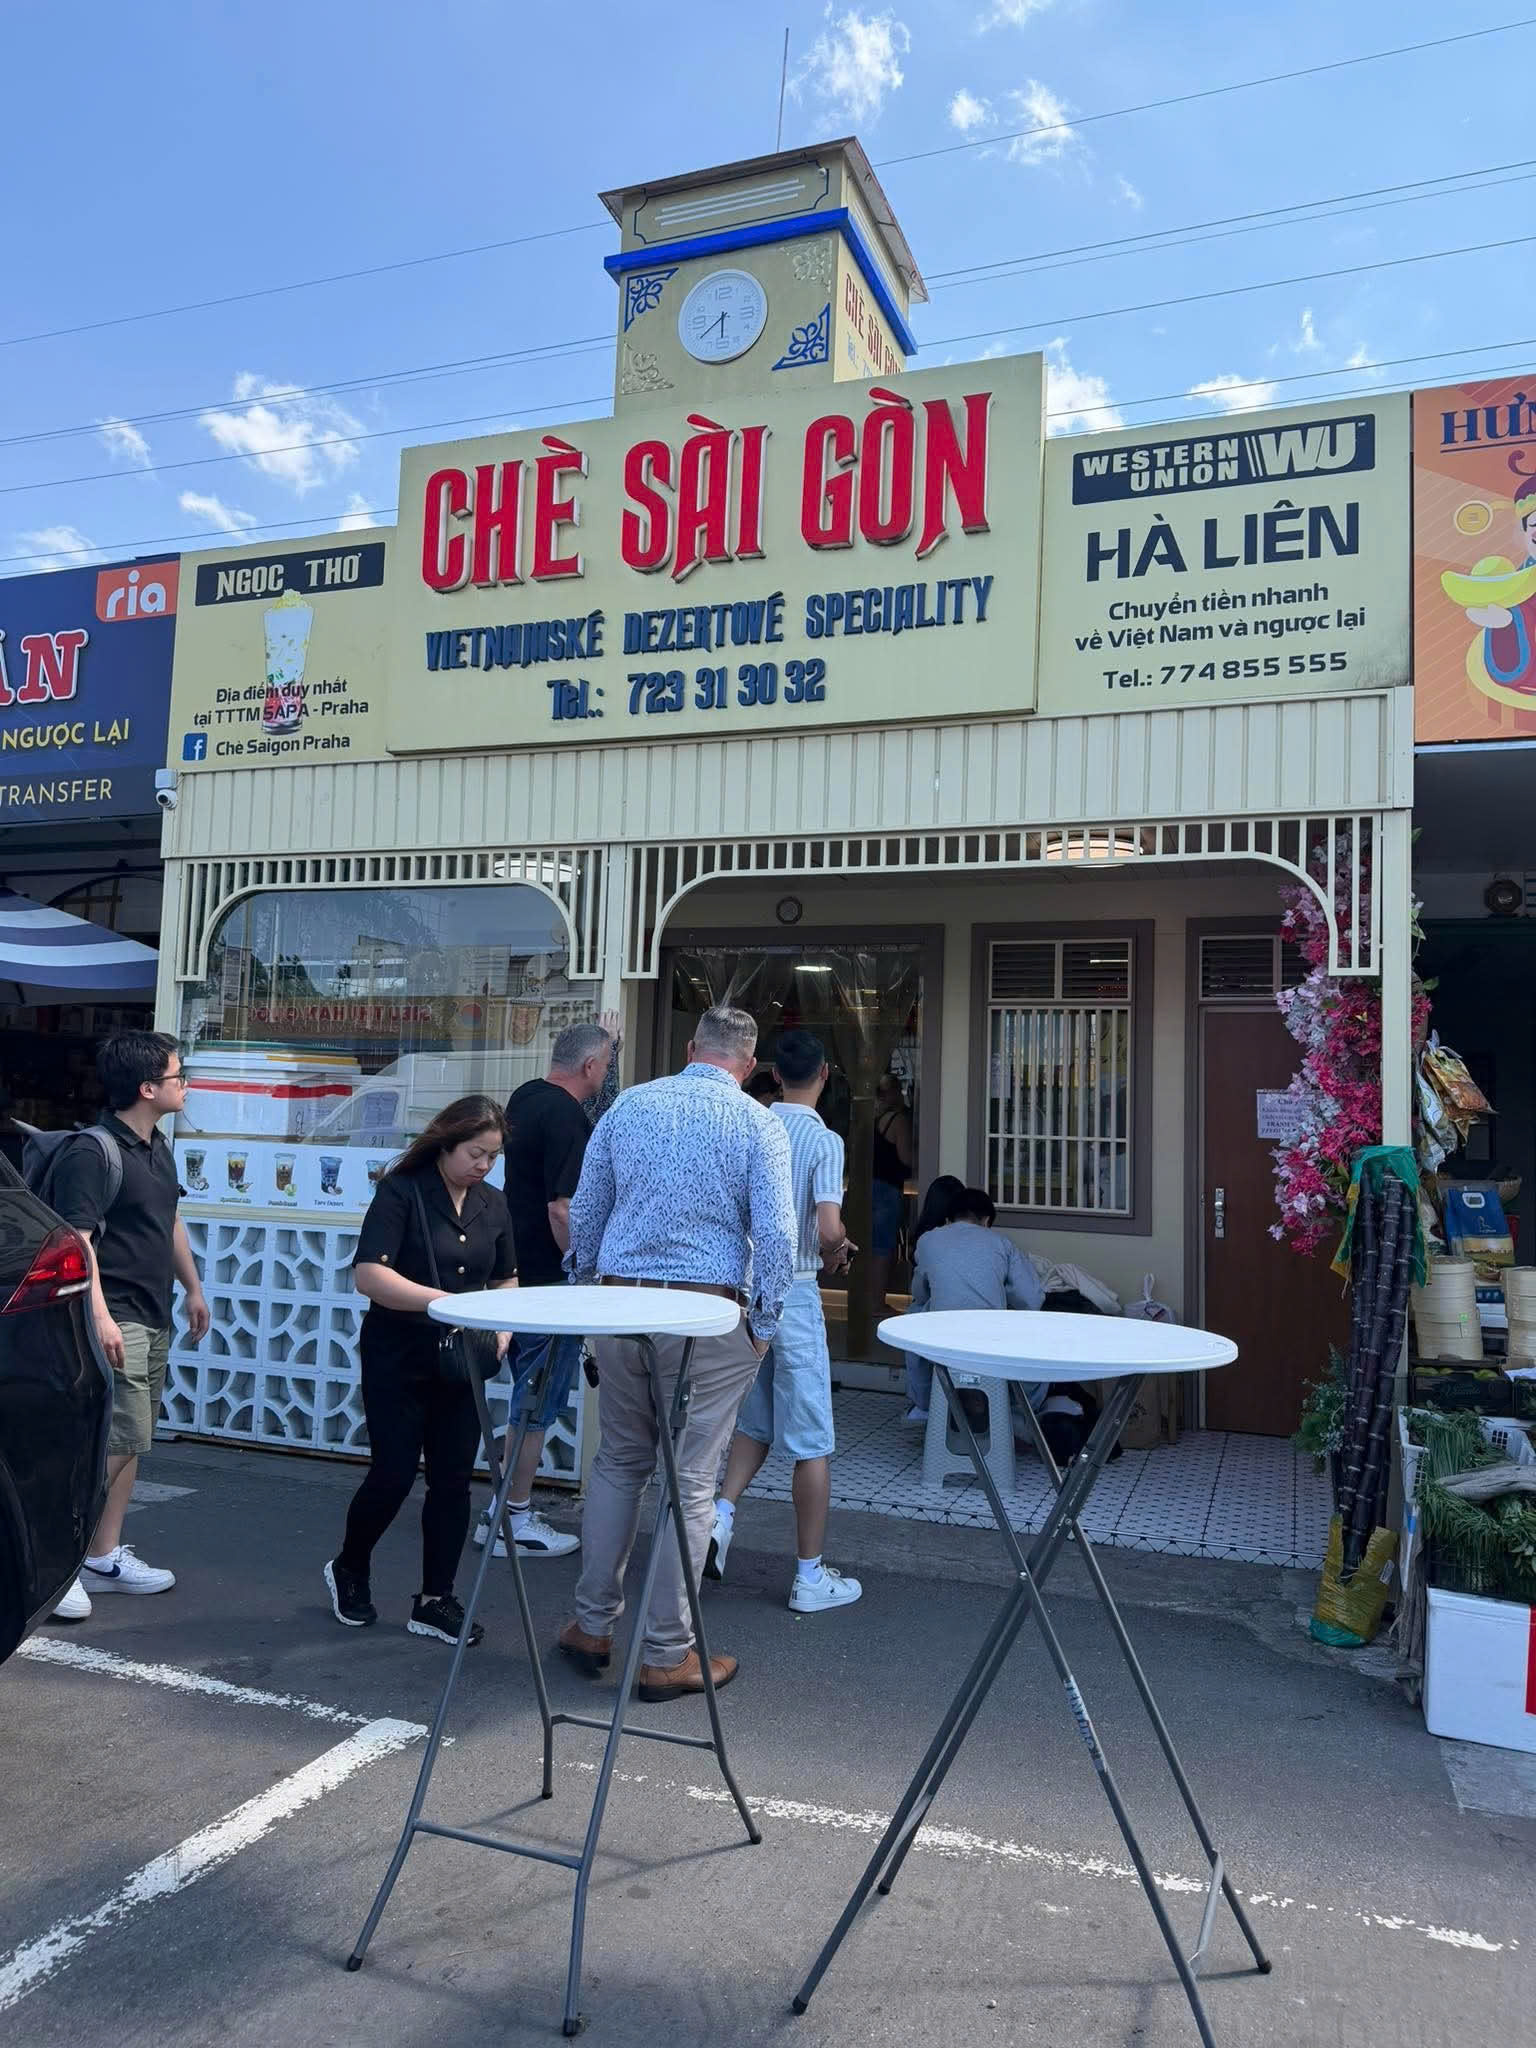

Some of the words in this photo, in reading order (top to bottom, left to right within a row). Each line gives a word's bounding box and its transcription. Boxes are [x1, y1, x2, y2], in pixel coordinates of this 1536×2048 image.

[1081, 438, 1239, 477] WESTERN
[1258, 422, 1356, 476] WU
[422, 436, 588, 594] CHÈ
[622, 413, 772, 583] SÀI
[801, 387, 993, 559] GÒN
[1130, 459, 1239, 492] UNION
[1086, 513, 1188, 582] HÀ
[1204, 500, 1360, 570] LIÊN
[106, 570, 167, 618] ria
[216, 564, 284, 601] NGỌC
[305, 553, 362, 587] THƠ
[426, 609, 605, 671] VIETNAMSKÉ
[623, 591, 785, 654] DEZERTOVÉ
[806, 575, 994, 638] SPECIALITY
[1109, 592, 1197, 620] Chuyển
[1202, 589, 1246, 611] tiền
[1252, 583, 1329, 607] nhanh
[1075, 632, 1102, 651] về
[1108, 629, 1154, 649] Việt
[1160, 624, 1213, 643] Nam
[1219, 619, 1248, 637] và
[1254, 614, 1330, 638] ngược
[1337, 607, 1365, 631] lại
[0, 628, 89, 706] N
[313, 676, 347, 696] nhất
[547, 679, 604, 720] Tel.:
[627, 670, 685, 714] 723
[695, 666, 727, 709] 31
[738, 663, 778, 706] 30
[784, 658, 826, 703] 32
[1103, 669, 1152, 689] Tel.:
[1161, 662, 1215, 685] 774
[1222, 657, 1280, 679] 855
[1289, 652, 1347, 674] 555
[2, 721, 85, 750] NGƯỢC
[94, 718, 130, 745] LẠI
[194, 712, 211, 728] tại
[215, 707, 260, 723] TTTM
[263, 703, 309, 721] SAPA
[321, 699, 368, 716] Praha
[216, 739, 243, 756] Chè
[246, 738, 300, 755] Saigon
[303, 734, 350, 750] Praha
